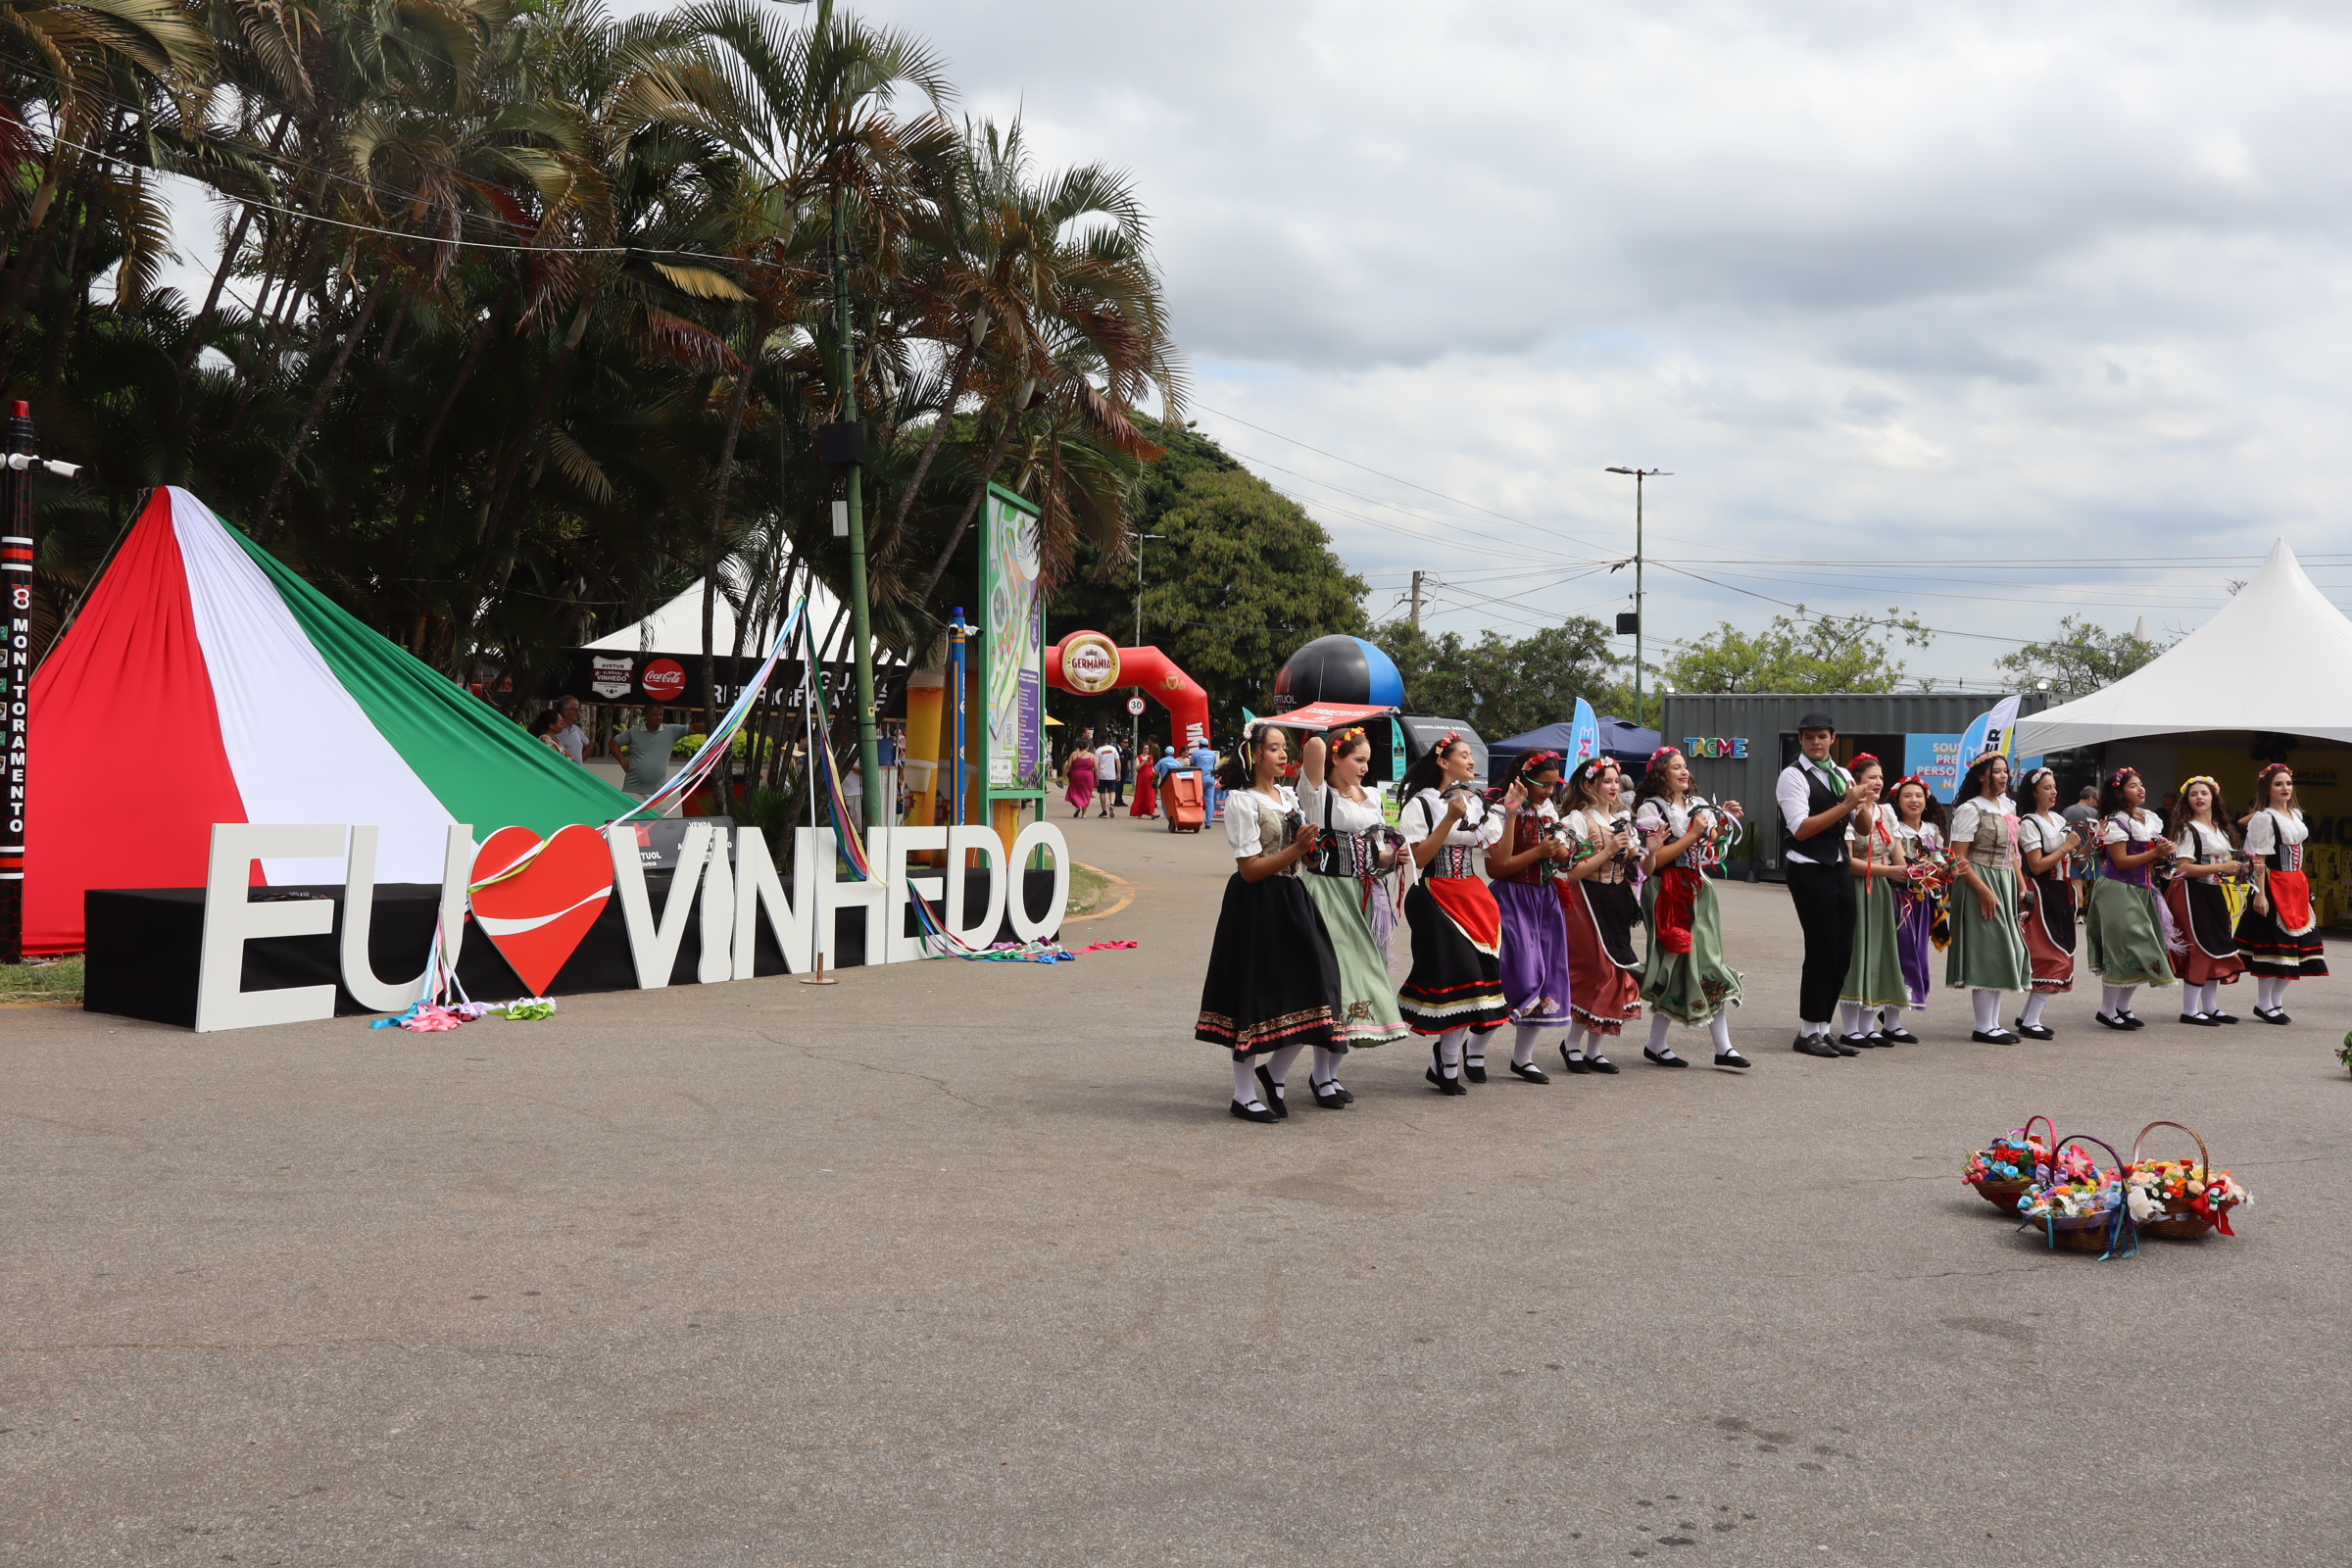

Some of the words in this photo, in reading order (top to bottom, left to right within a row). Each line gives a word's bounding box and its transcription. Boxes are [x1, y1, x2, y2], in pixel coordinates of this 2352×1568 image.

[1130, 701, 1142, 710] 30
[10, 618, 28, 833] MONITORAMENTO
[1684, 737, 1748, 759] TAGME
[640, 851, 662, 859] TUOL
[196, 823, 473, 1032] EU
